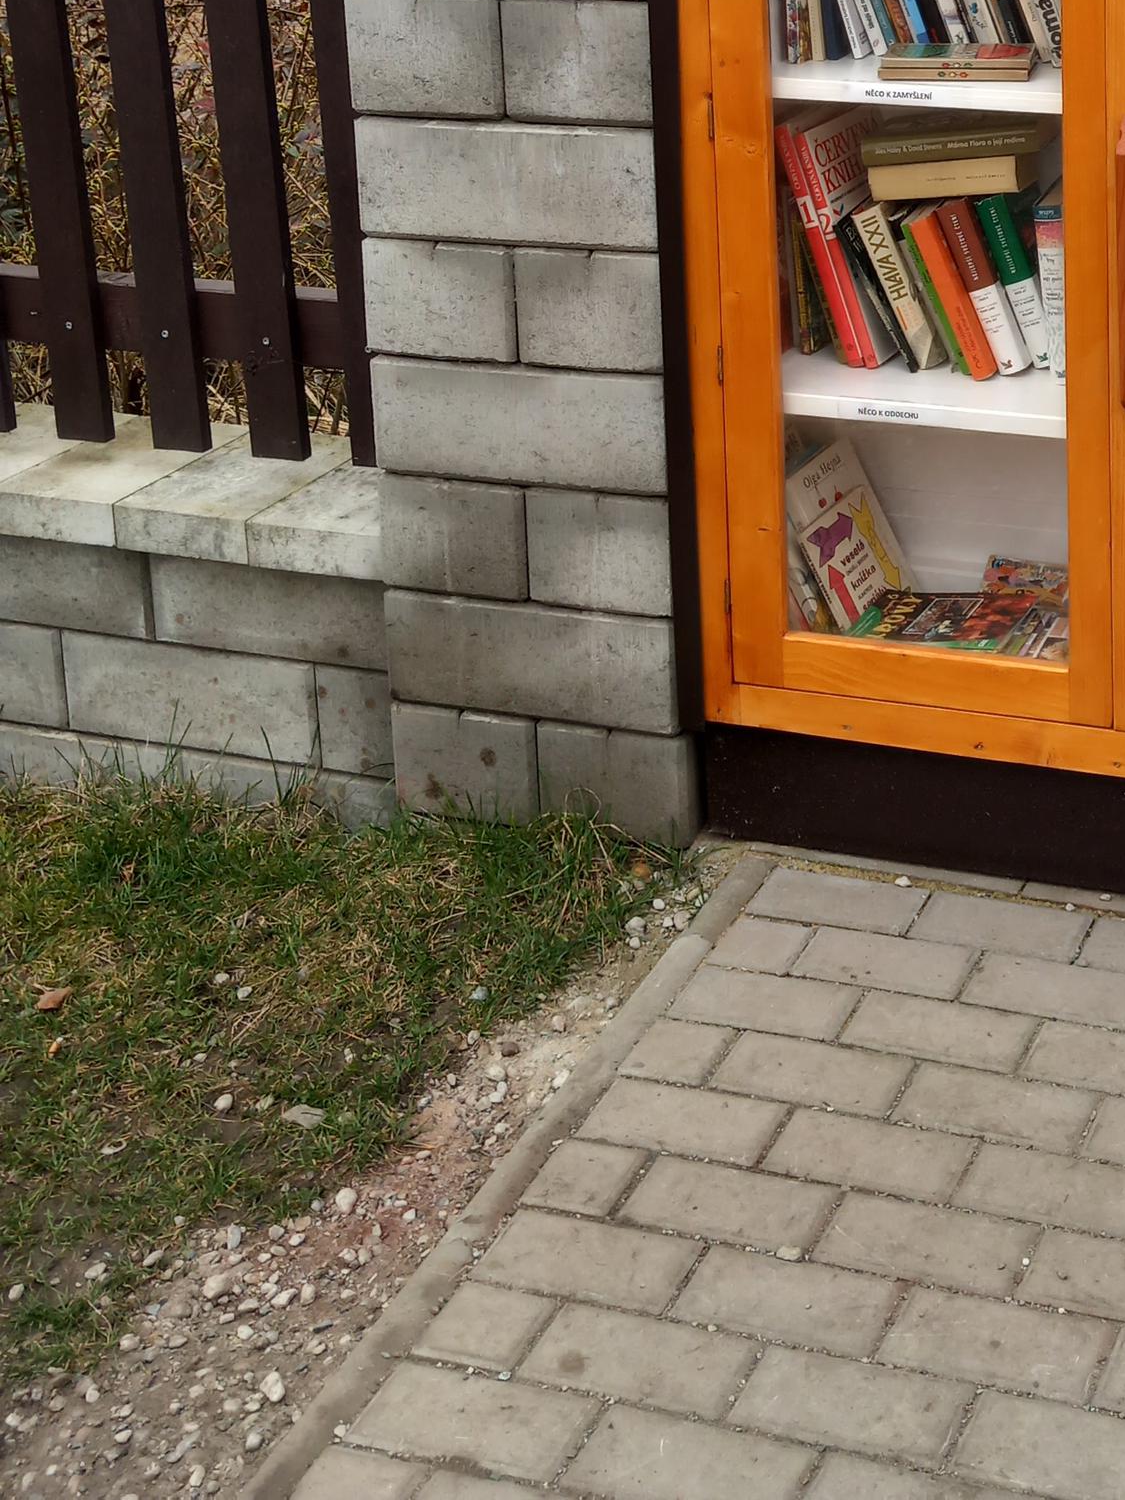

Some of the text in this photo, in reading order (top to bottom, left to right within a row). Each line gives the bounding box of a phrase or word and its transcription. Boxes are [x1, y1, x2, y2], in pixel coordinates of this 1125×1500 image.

[865, 88, 885, 97] NĚCO
[892, 91, 933, 100] ZAMYŠLENÍ
[822, 155, 864, 196] KNIH
[797, 200, 814, 226] 1
[819, 212, 833, 234] 2
[860, 214, 889, 250] XXII
[878, 255, 909, 301] HLAVA
[964, 256, 979, 281] NEJLEPŠÍ
[858, 407, 877, 416] NĚCO
[884, 410, 919, 419] ODDECHU
[803, 472, 821, 489] Olga
[840, 539, 866, 567] veselá
[850, 564, 877, 591] knížka
